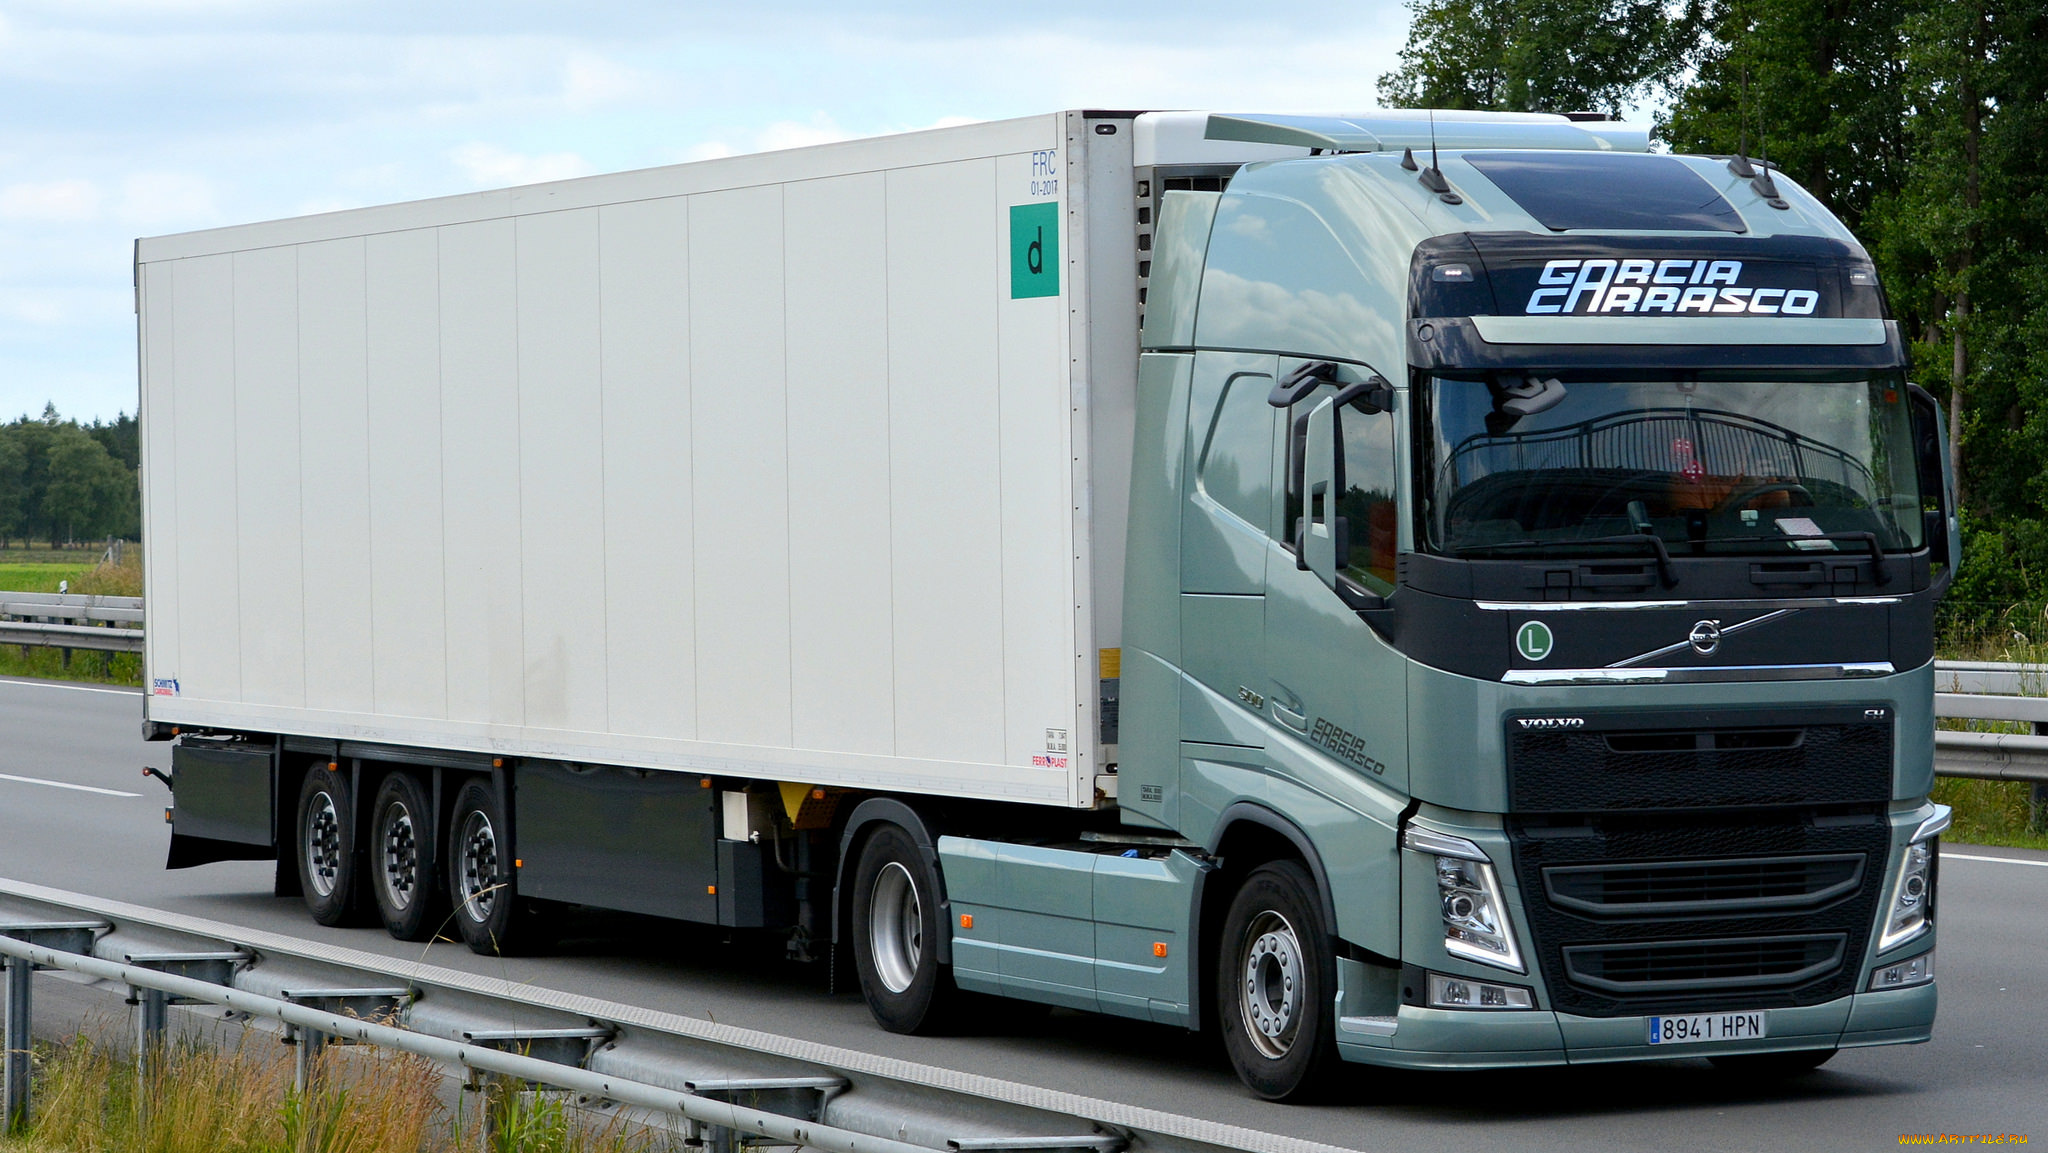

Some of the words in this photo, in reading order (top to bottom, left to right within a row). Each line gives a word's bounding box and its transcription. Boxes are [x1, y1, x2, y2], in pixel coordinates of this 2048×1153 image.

[1032, 151, 1056, 177] FRC
[1028, 225, 1042, 274] d
[1538, 259, 1743, 298] GARCIA
[1525, 280, 1820, 314] CARRASCO
[1528, 629, 1543, 653] L
[1314, 717, 1366, 752] GARCIA
[1517, 718, 1584, 729] VOLVO
[1663, 1017, 1712, 1040] 8941
[1722, 1015, 1759, 1037] HPN
